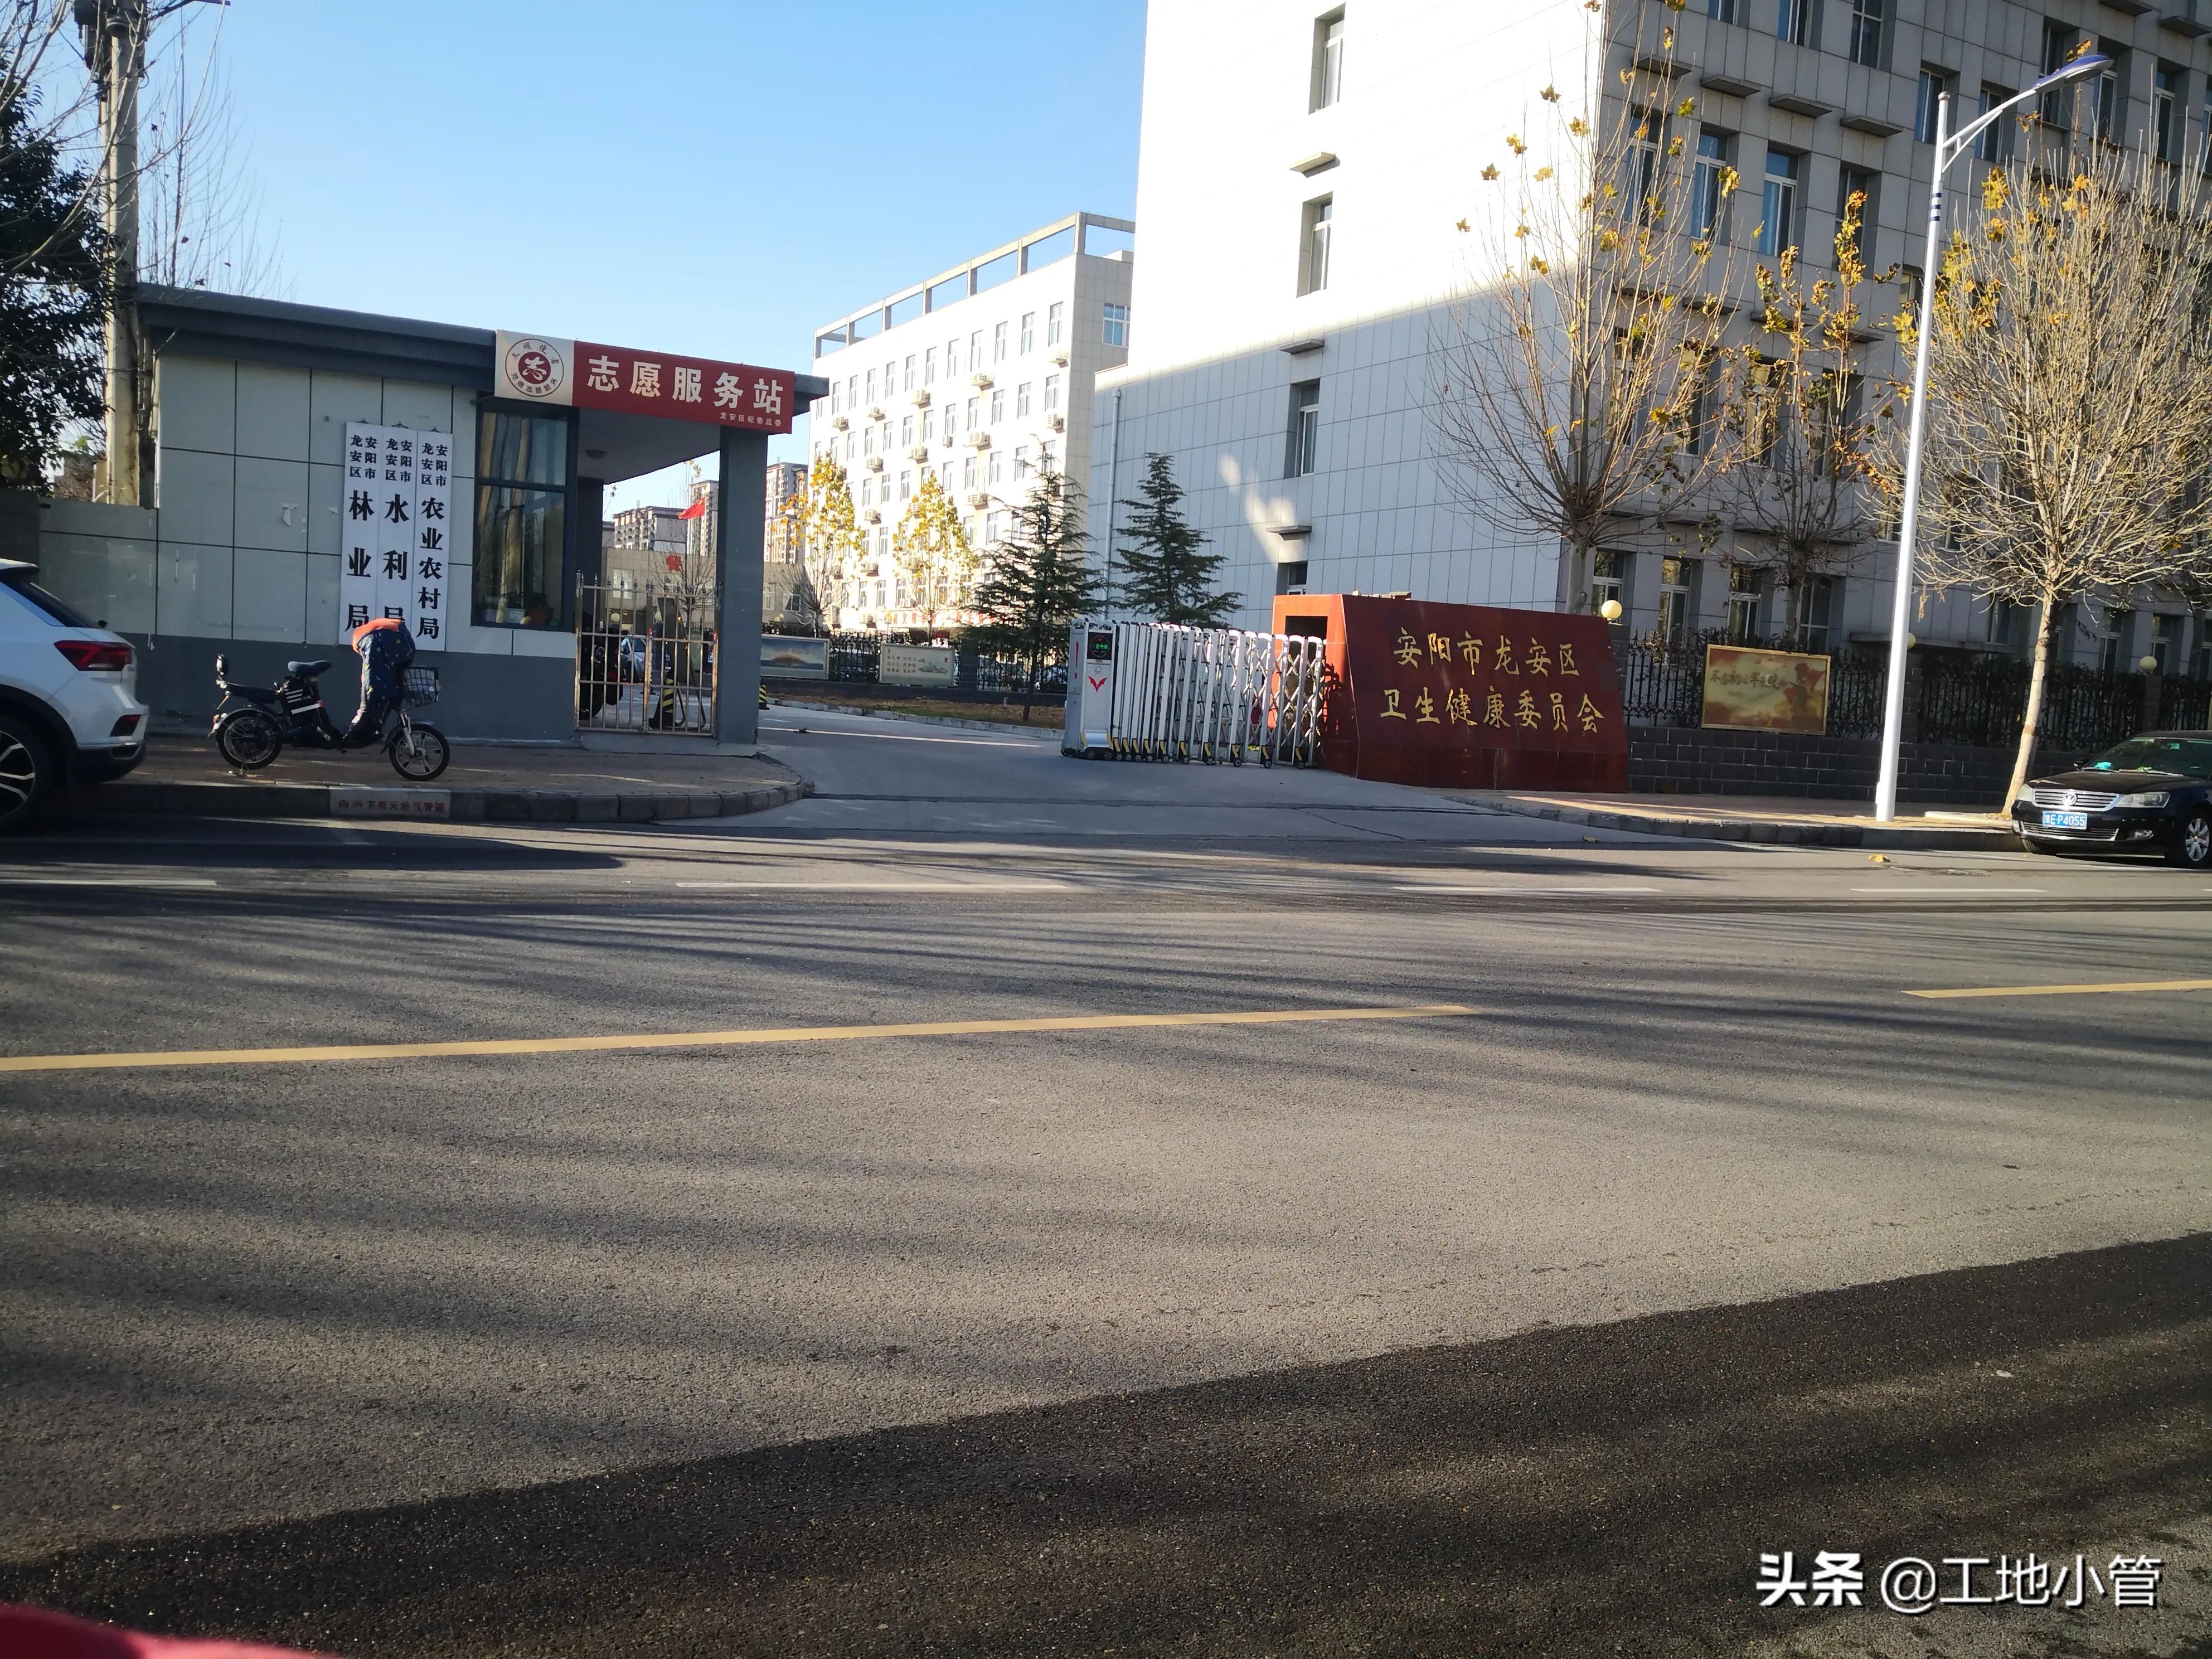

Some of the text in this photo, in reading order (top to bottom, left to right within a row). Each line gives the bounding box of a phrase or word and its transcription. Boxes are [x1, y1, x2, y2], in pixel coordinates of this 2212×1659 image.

[587, 355, 783, 415] 志愿服务站
[720, 411, 782, 426] 龙安区纪委监委
[349, 434, 363, 478] 龙安区
[364, 436, 377, 479] 安阳市
[385, 438, 398, 481] 龙安区
[400, 440, 413, 483] 安阳市
[421, 443, 434, 486] 龙安区
[435, 444, 448, 487] 安阳市
[345, 489, 375, 632] 林业局
[416, 497, 445, 639] 农业农村局
[1393, 627, 1581, 677] 安阳市龙安区
[1380, 685, 1605, 734] 卫生健康委员会
